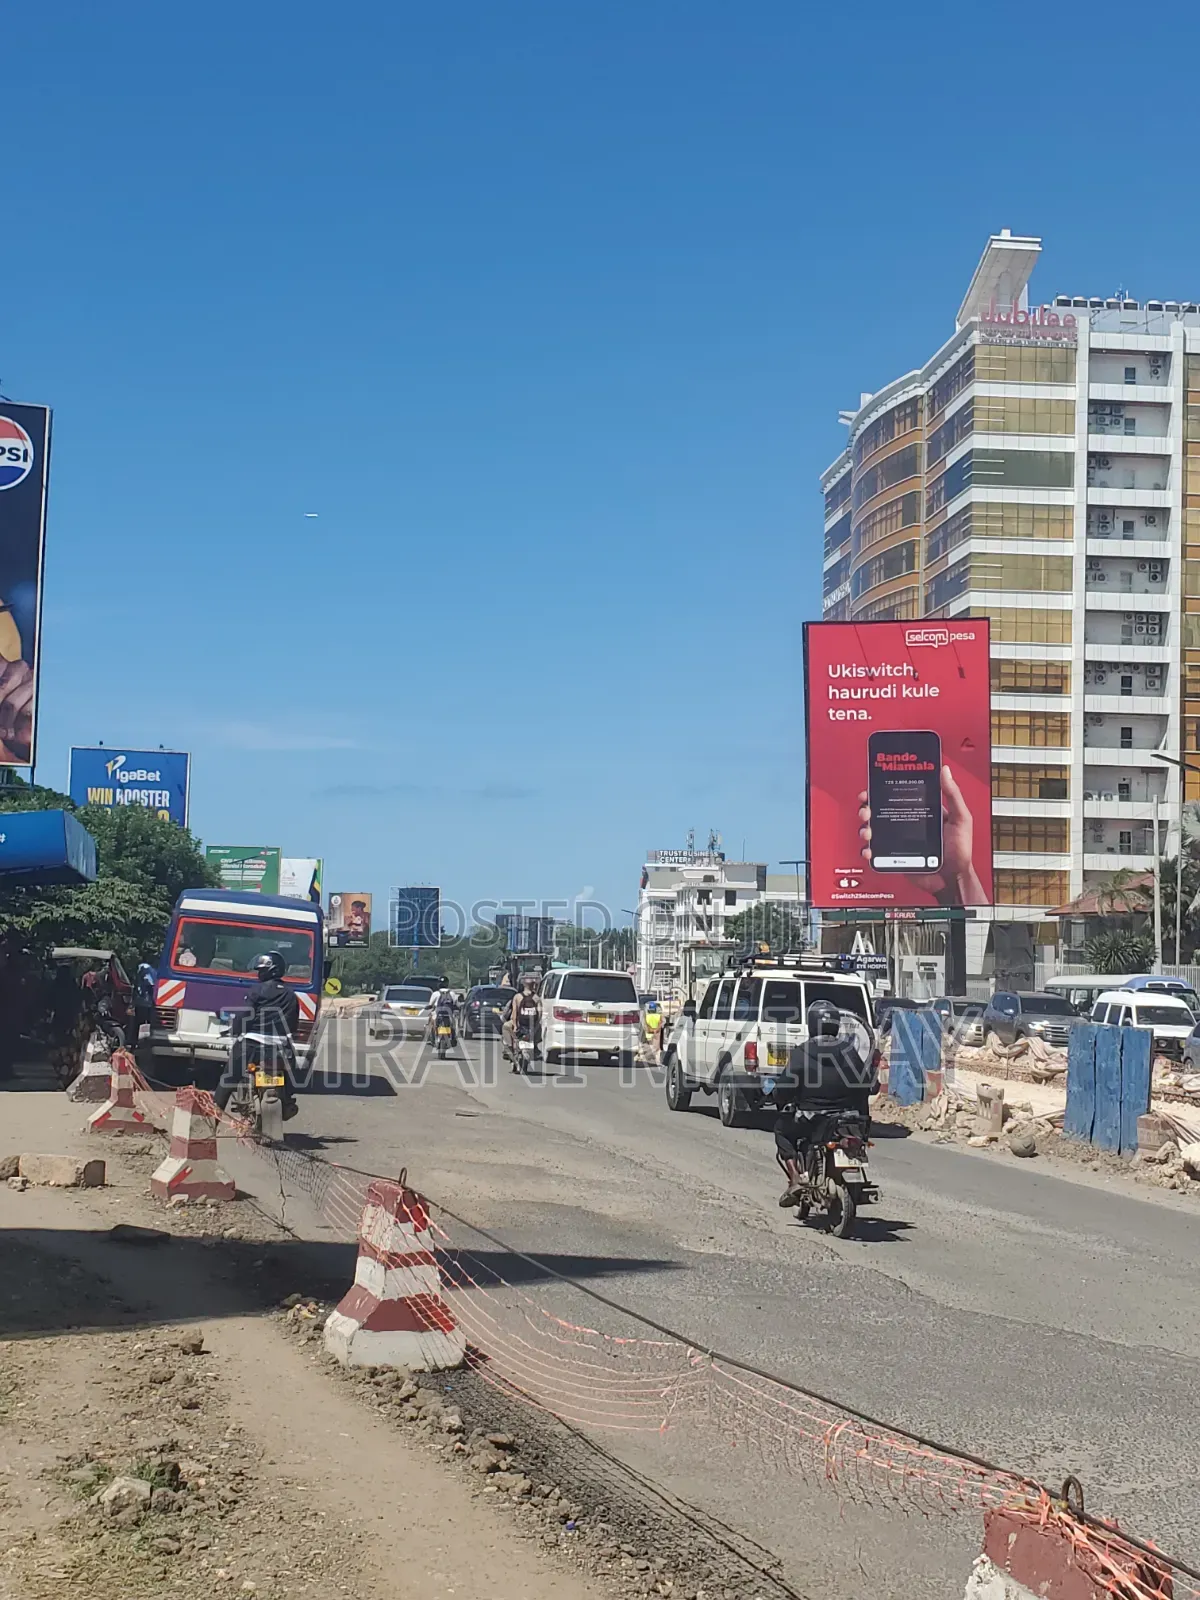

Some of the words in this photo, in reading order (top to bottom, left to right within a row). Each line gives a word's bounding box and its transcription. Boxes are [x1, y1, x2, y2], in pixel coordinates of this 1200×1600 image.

[907, 630, 948, 648] selcom
[949, 632, 976, 643] pesa
[828, 662, 918, 679] Ukiswitch,
[828, 684, 897, 700] haurudi
[902, 683, 940, 698] kule
[828, 707, 872, 721] tena.
[876, 752, 918, 762] Bando
[882, 761, 935, 771] Miamala
[87, 787, 113, 805] WIN
[115, 788, 170, 808] BOOSTER
